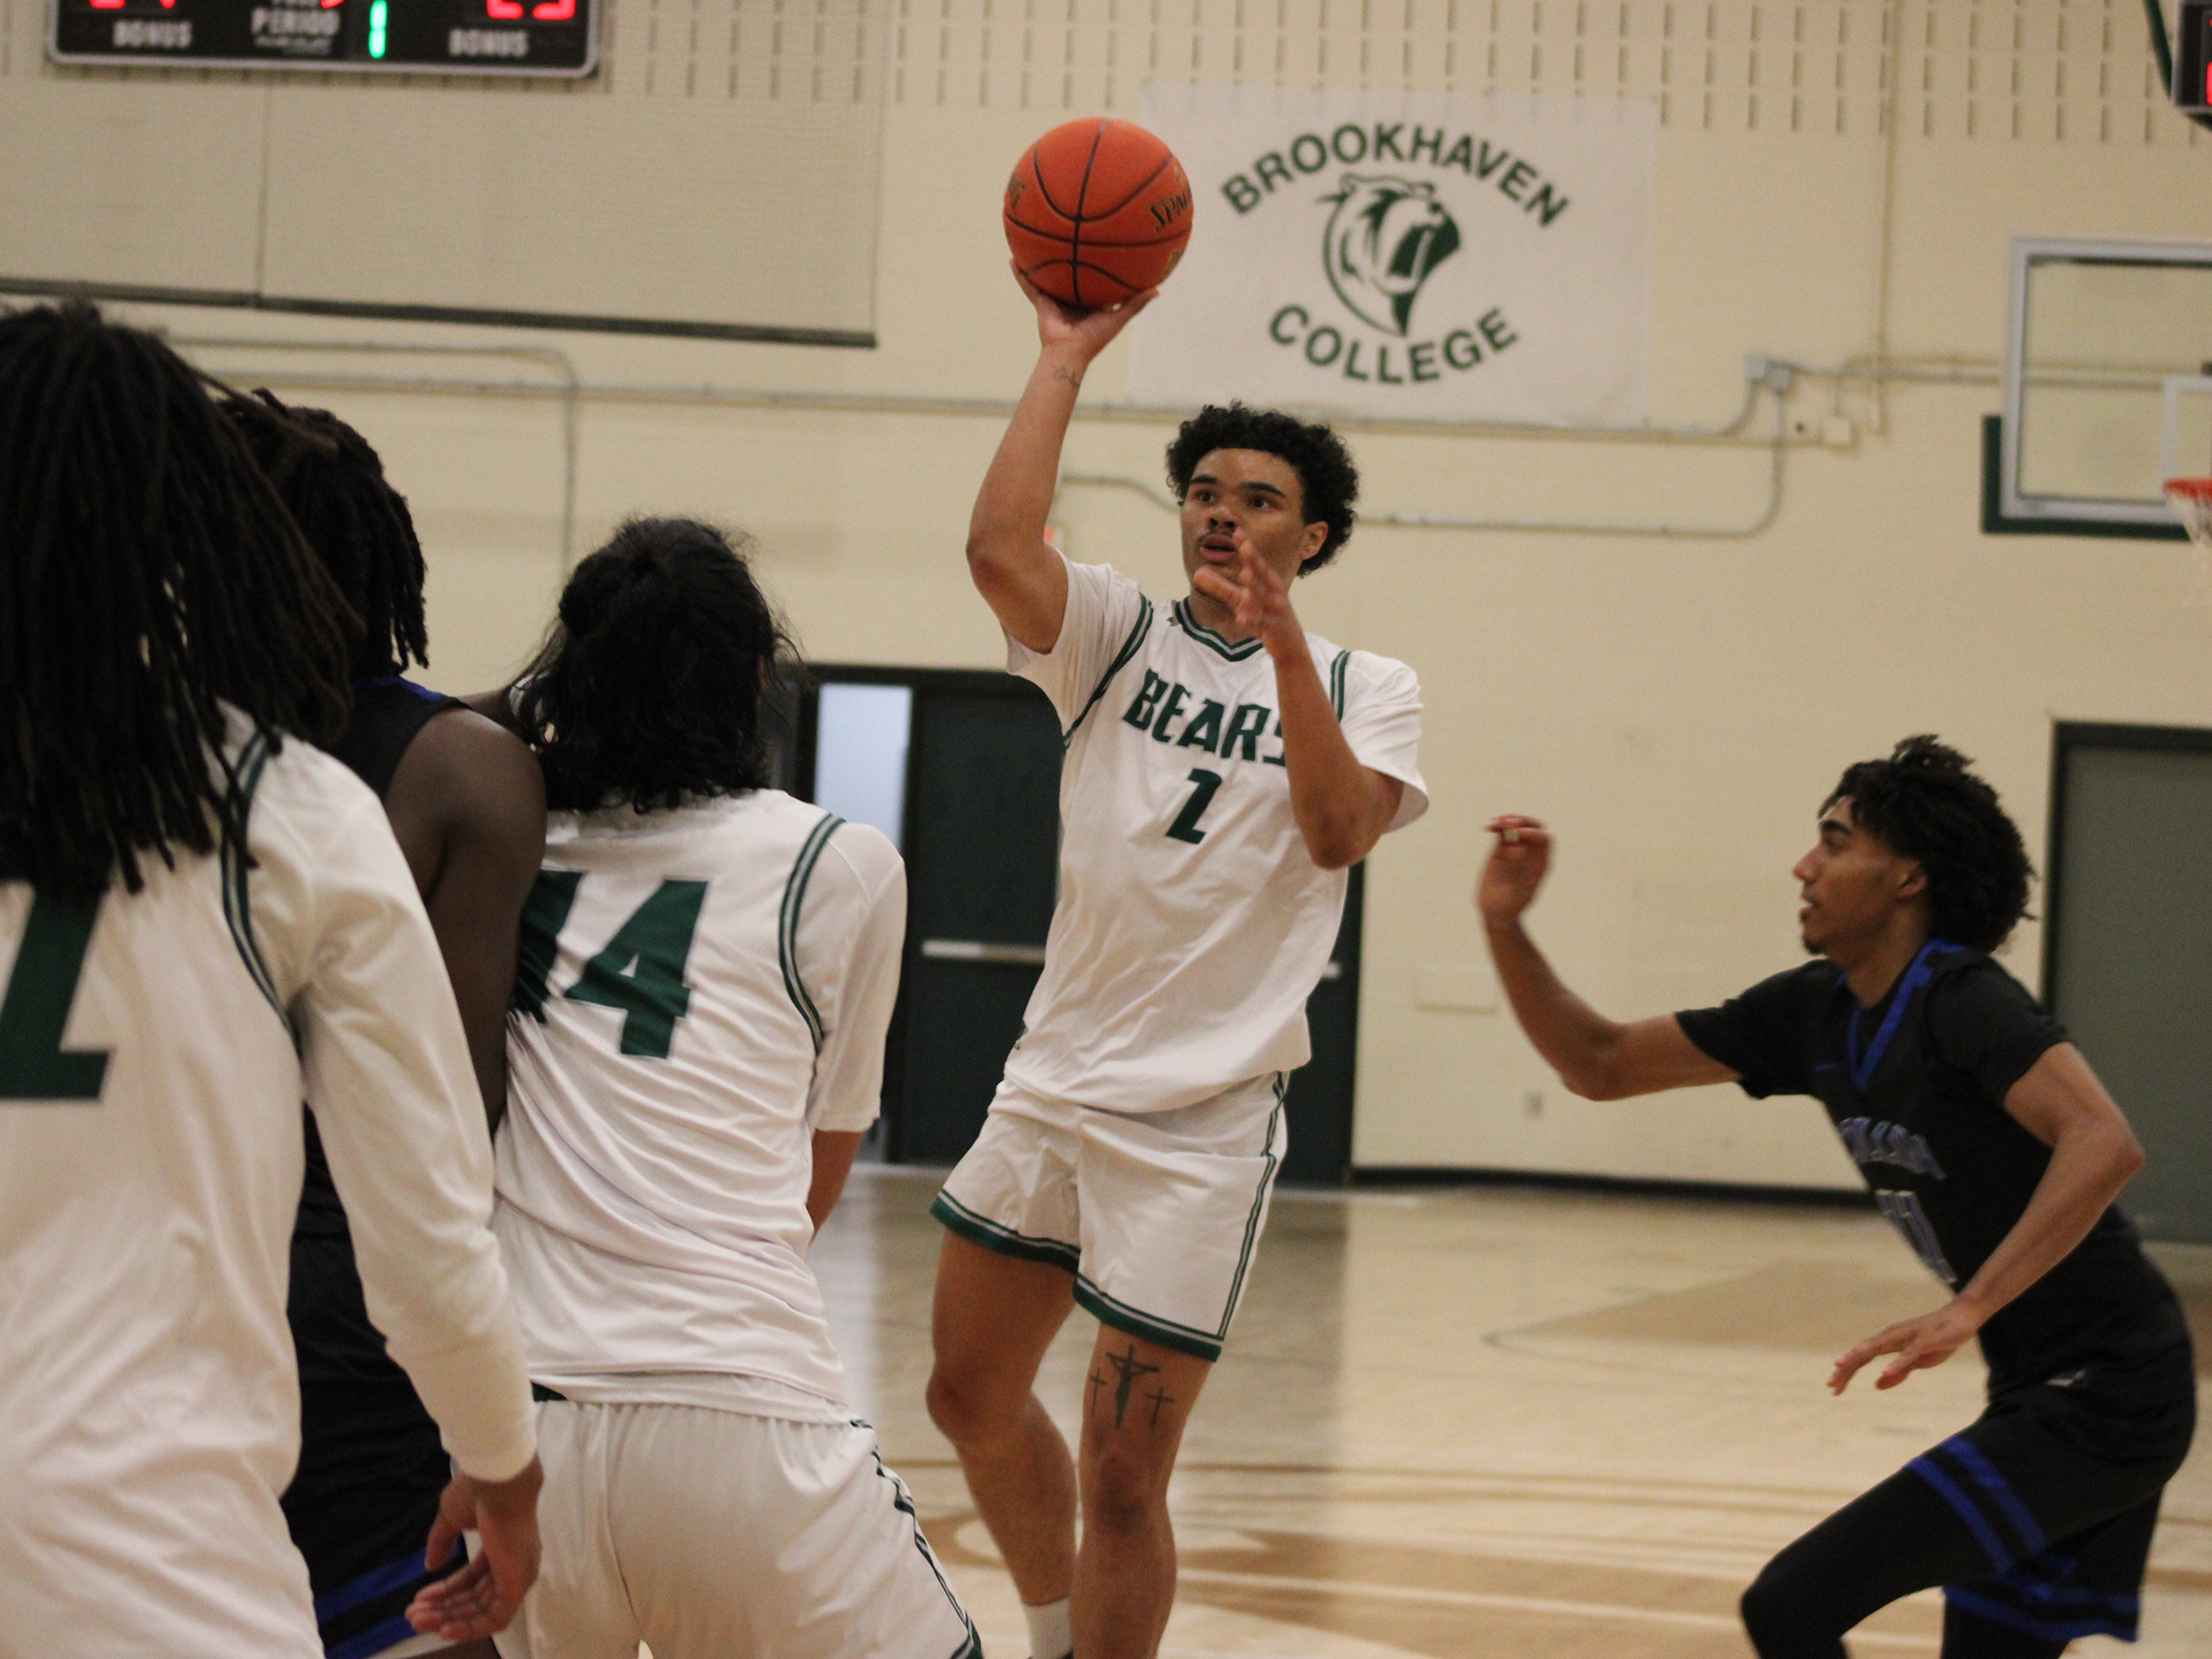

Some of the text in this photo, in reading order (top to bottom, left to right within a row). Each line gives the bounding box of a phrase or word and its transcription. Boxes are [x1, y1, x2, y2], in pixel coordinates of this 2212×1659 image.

[113, 20, 193, 48] BONUS
[252, 7, 340, 36] PERIOD
[449, 28, 528, 57] BONUS
[1220, 123, 1569, 228] BROOKHAVEN
[1269, 304, 1518, 384] COLLEGE
[1165, 768, 1223, 844] 2
